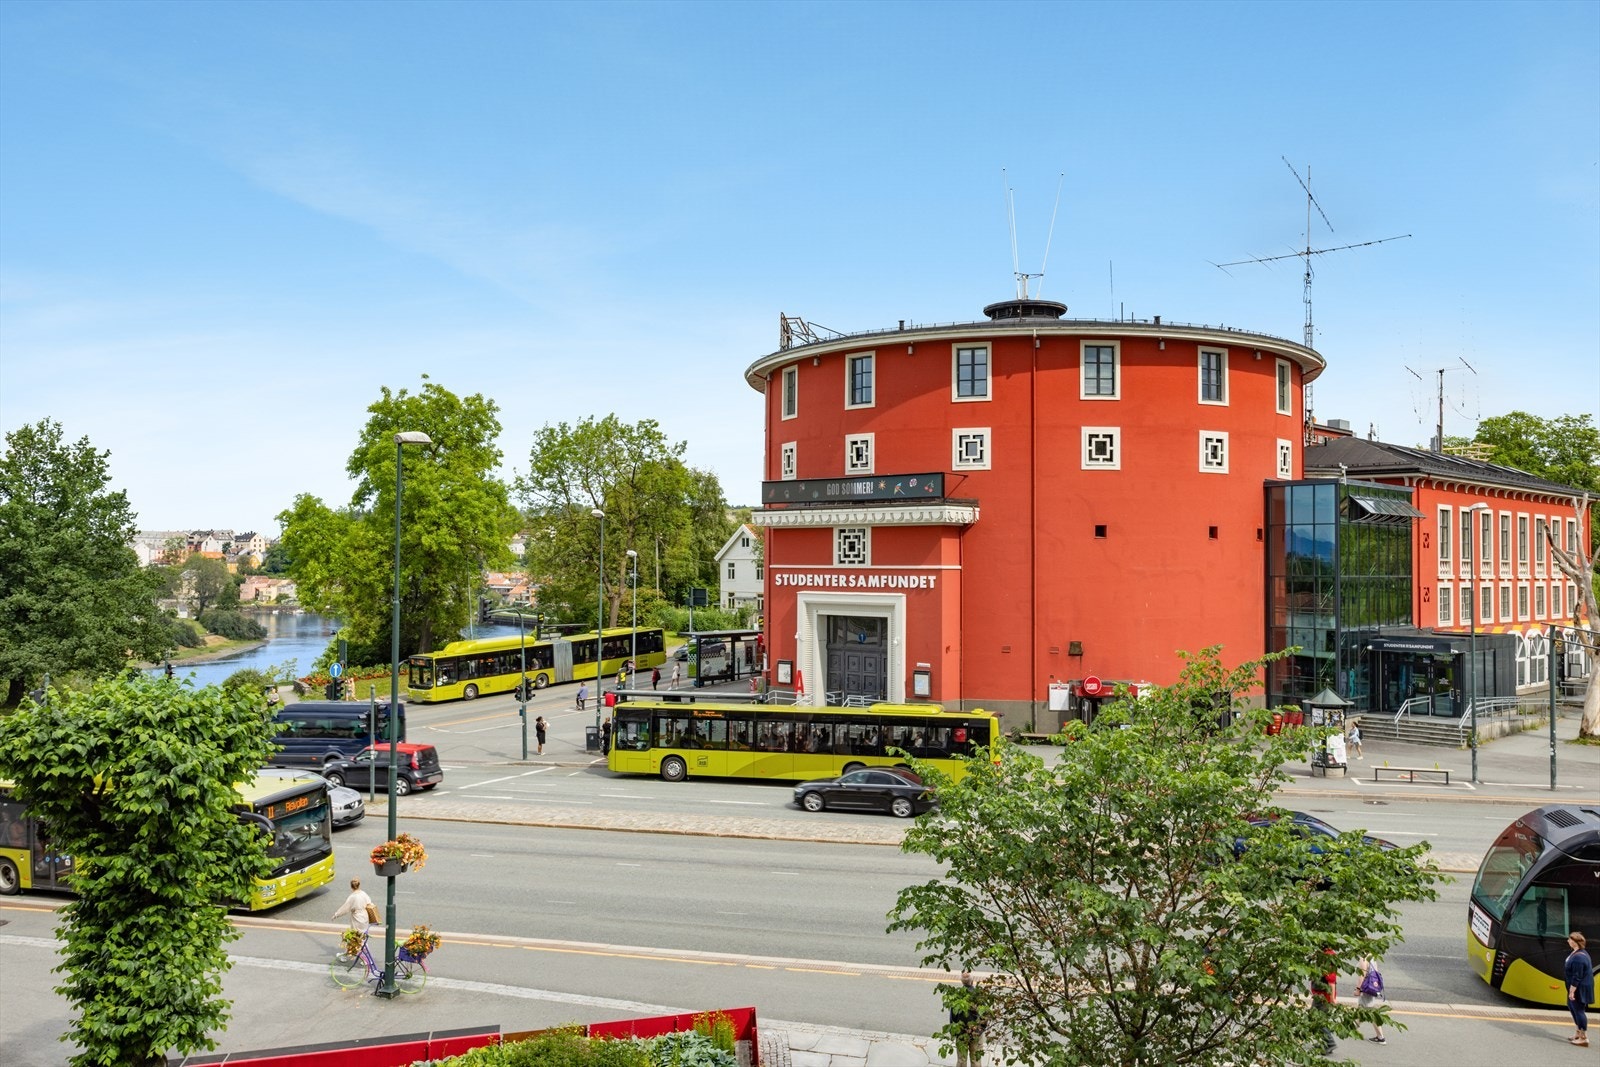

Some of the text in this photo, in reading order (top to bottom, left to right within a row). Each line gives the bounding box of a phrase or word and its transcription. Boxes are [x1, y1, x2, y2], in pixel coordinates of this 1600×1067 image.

[826, 481, 874, 496] GOD SOMMER!
[775, 573, 937, 589] STUDENTERSAMFUNDET
